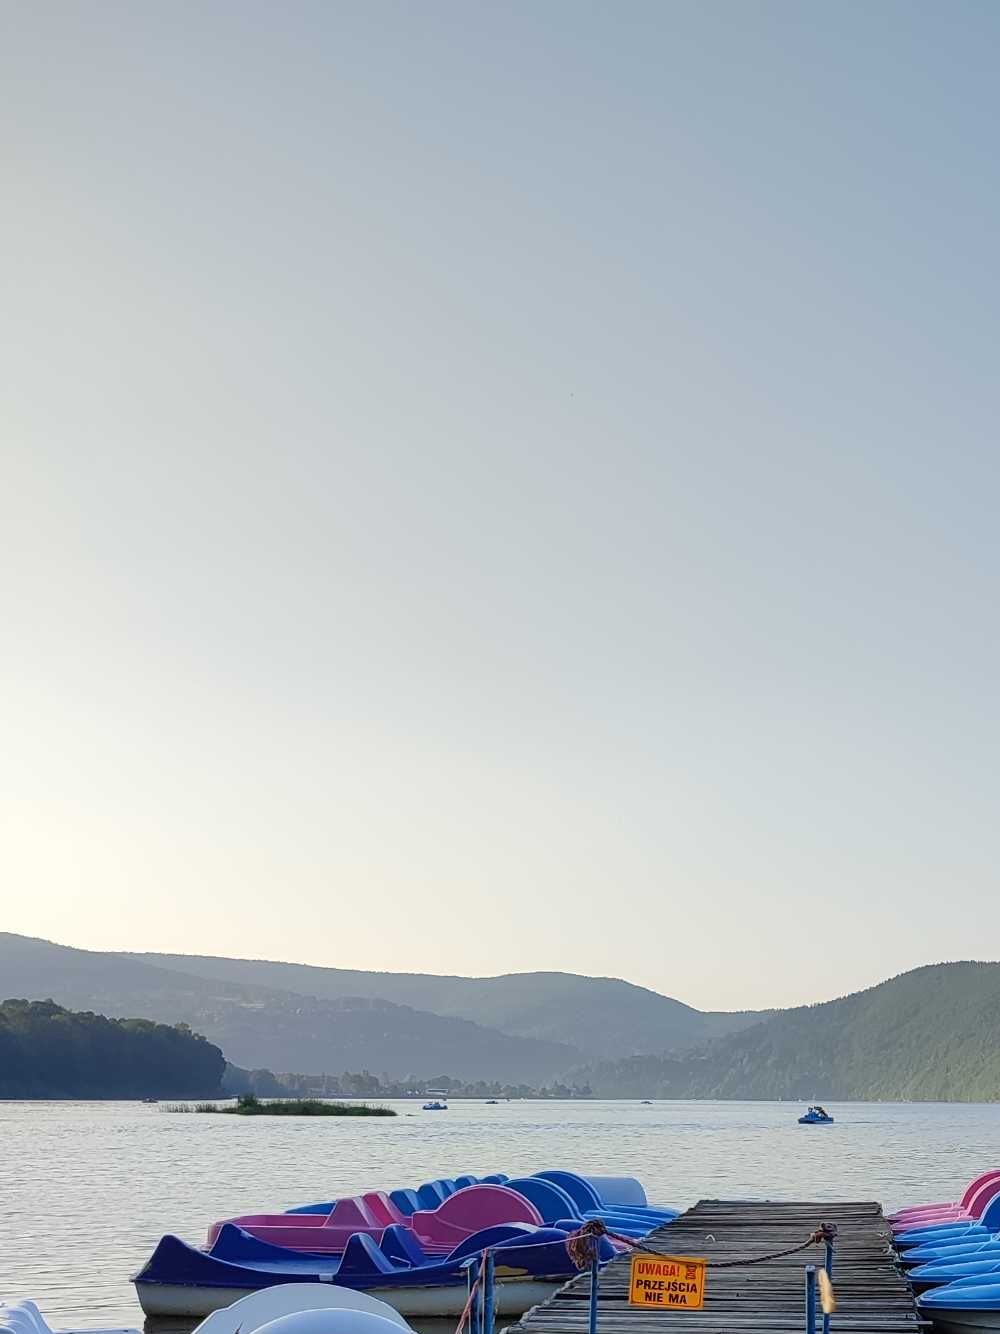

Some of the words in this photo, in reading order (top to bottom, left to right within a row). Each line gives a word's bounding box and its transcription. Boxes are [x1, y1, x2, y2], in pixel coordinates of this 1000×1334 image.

[638, 1263, 680, 1277] UWAGA!
[636, 1279, 698, 1293] PRZEJŚCIA
[645, 1292, 664, 1302] NIE
[669, 1293, 687, 1304] MA
